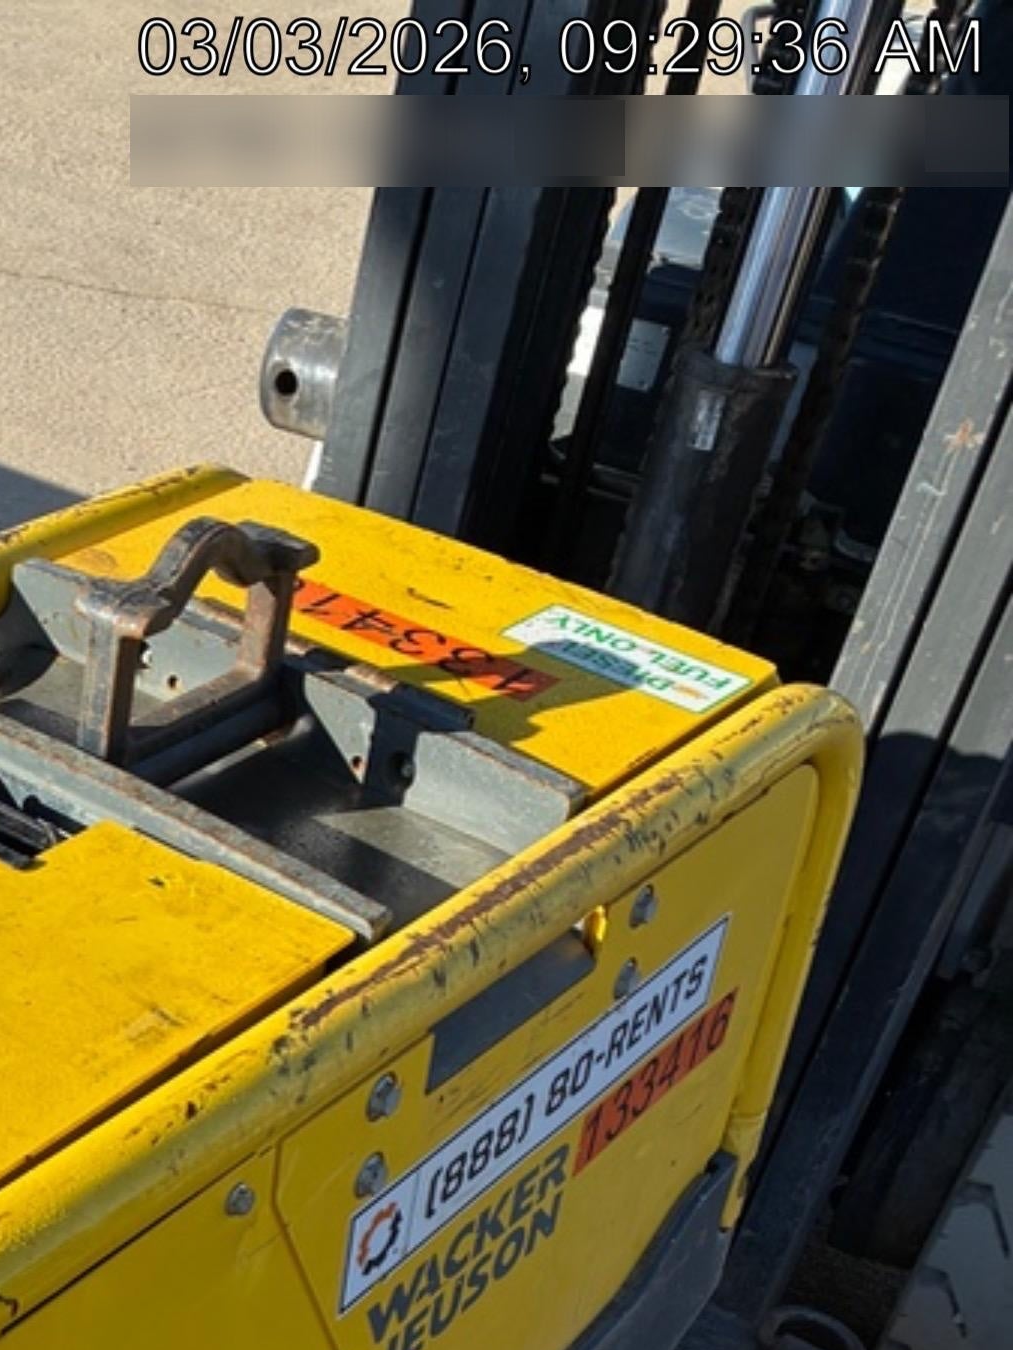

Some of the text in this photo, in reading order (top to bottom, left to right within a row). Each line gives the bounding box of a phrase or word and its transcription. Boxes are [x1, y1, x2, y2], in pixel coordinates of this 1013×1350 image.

[546, 613, 732, 690] FUEL ONLY
[560, 640, 674, 692] DIESEL
[587, 988, 736, 1164] 133416
[424, 1093, 534, 1219] (888)
[367, 1143, 571, 1344] WACKER
